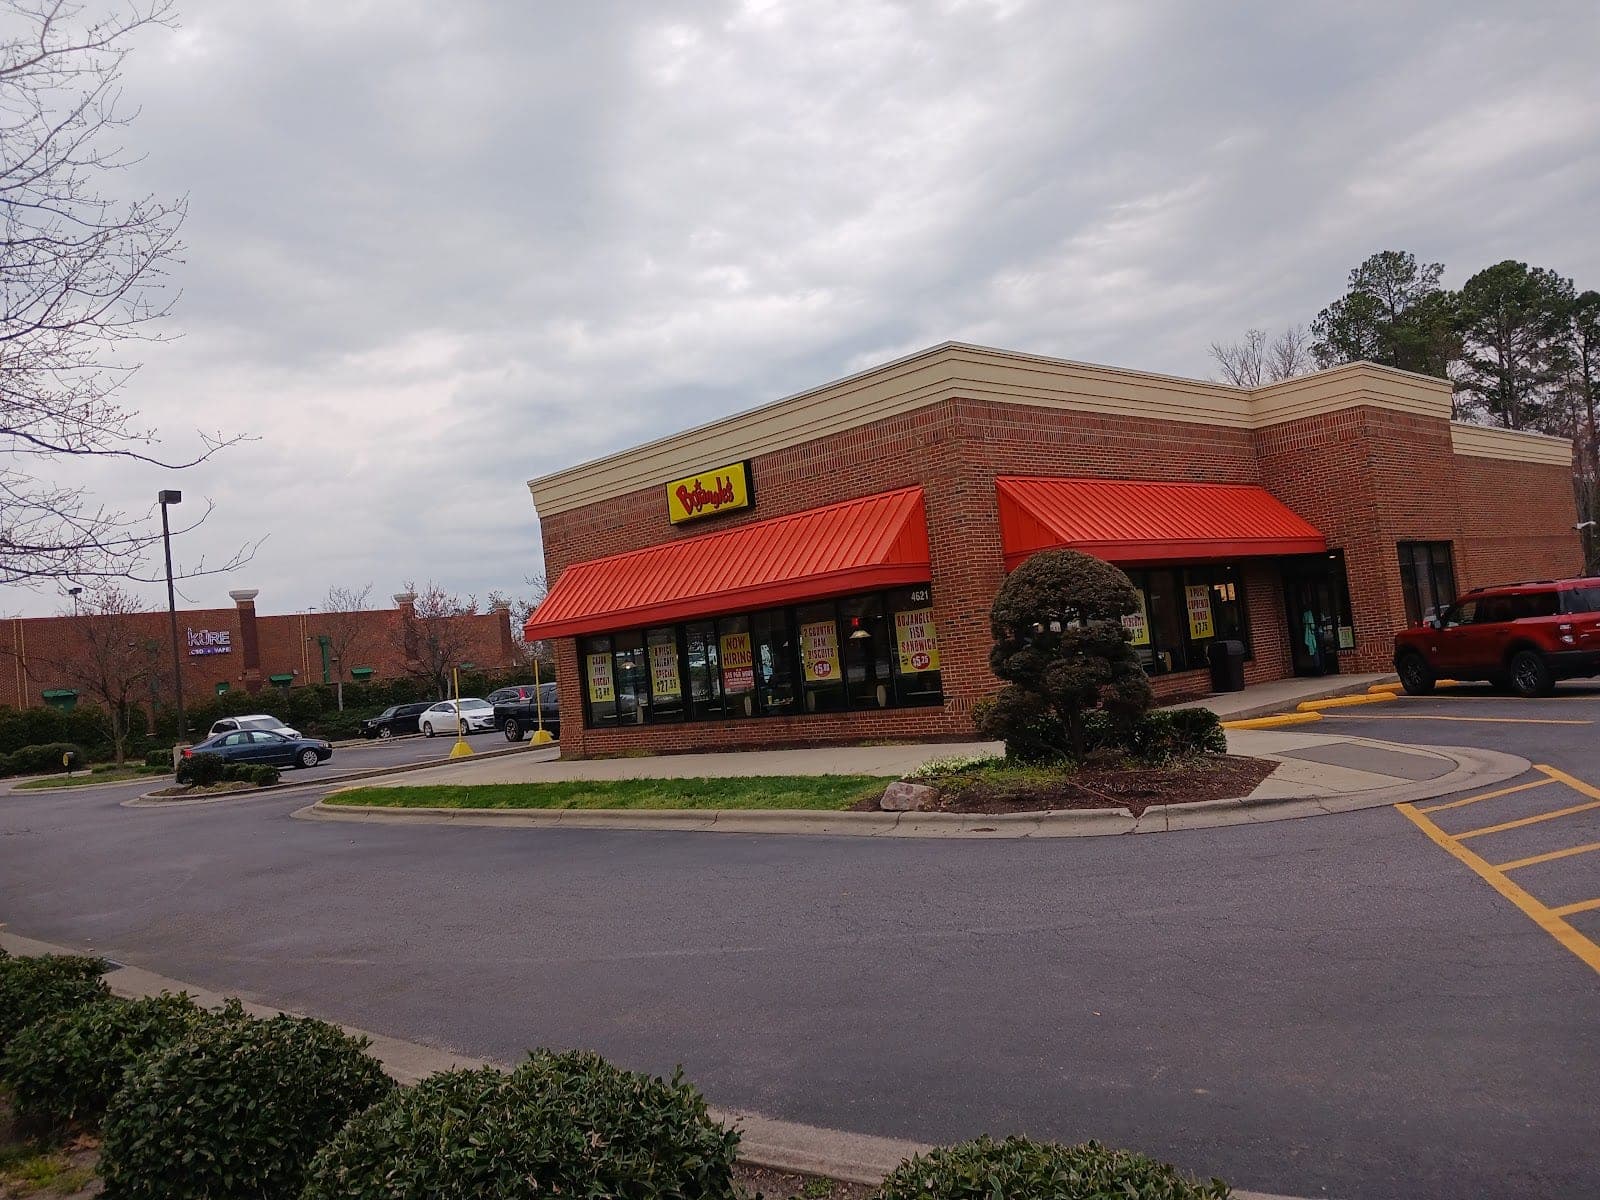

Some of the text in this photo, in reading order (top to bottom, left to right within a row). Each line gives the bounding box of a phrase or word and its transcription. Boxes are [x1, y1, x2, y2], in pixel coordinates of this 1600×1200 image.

[910, 589, 929, 602] 4621
[910, 625, 925, 639] FISH
[725, 636, 745, 650] NOW
[813, 636, 826, 648] HAM
[902, 638, 937, 653] SANDWICH
[723, 650, 752, 667] HIRING
